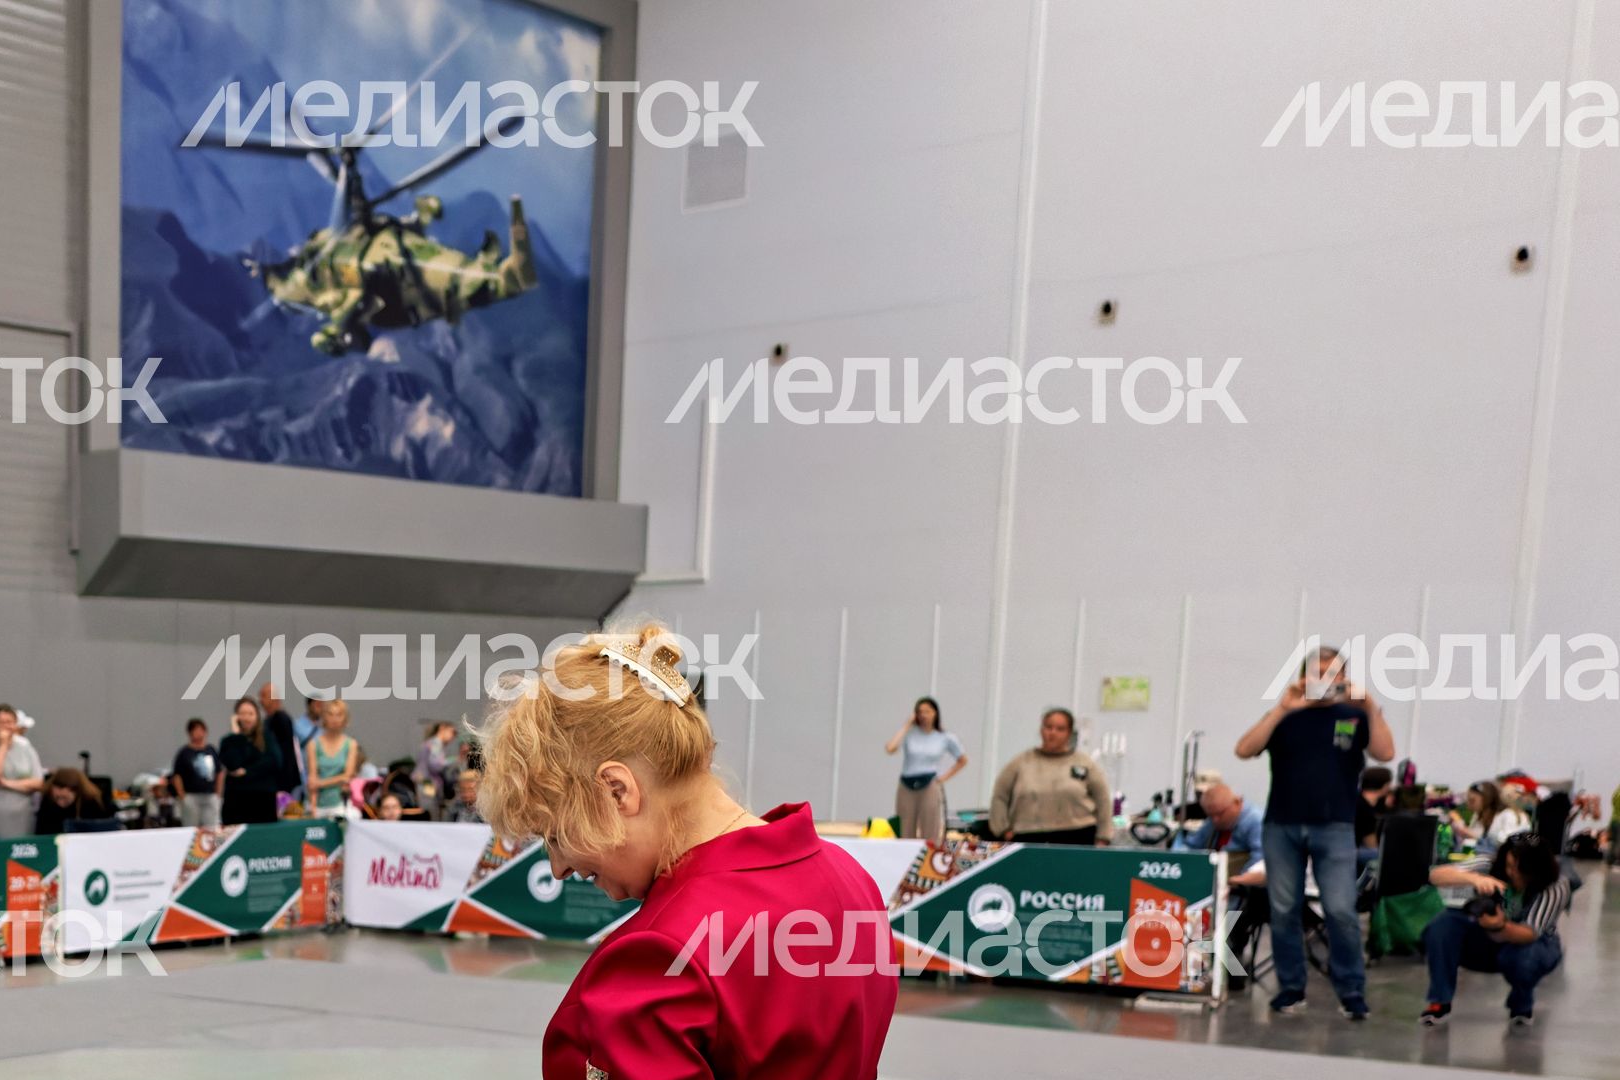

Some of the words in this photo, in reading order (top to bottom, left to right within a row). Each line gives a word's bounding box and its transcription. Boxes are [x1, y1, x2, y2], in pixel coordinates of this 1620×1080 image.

[248, 855, 293, 872] РОССИЯ
[367, 853, 445, 890] Molina
[1139, 861, 1182, 879] 2026
[1020, 889, 1106, 912] РОССИЯ
